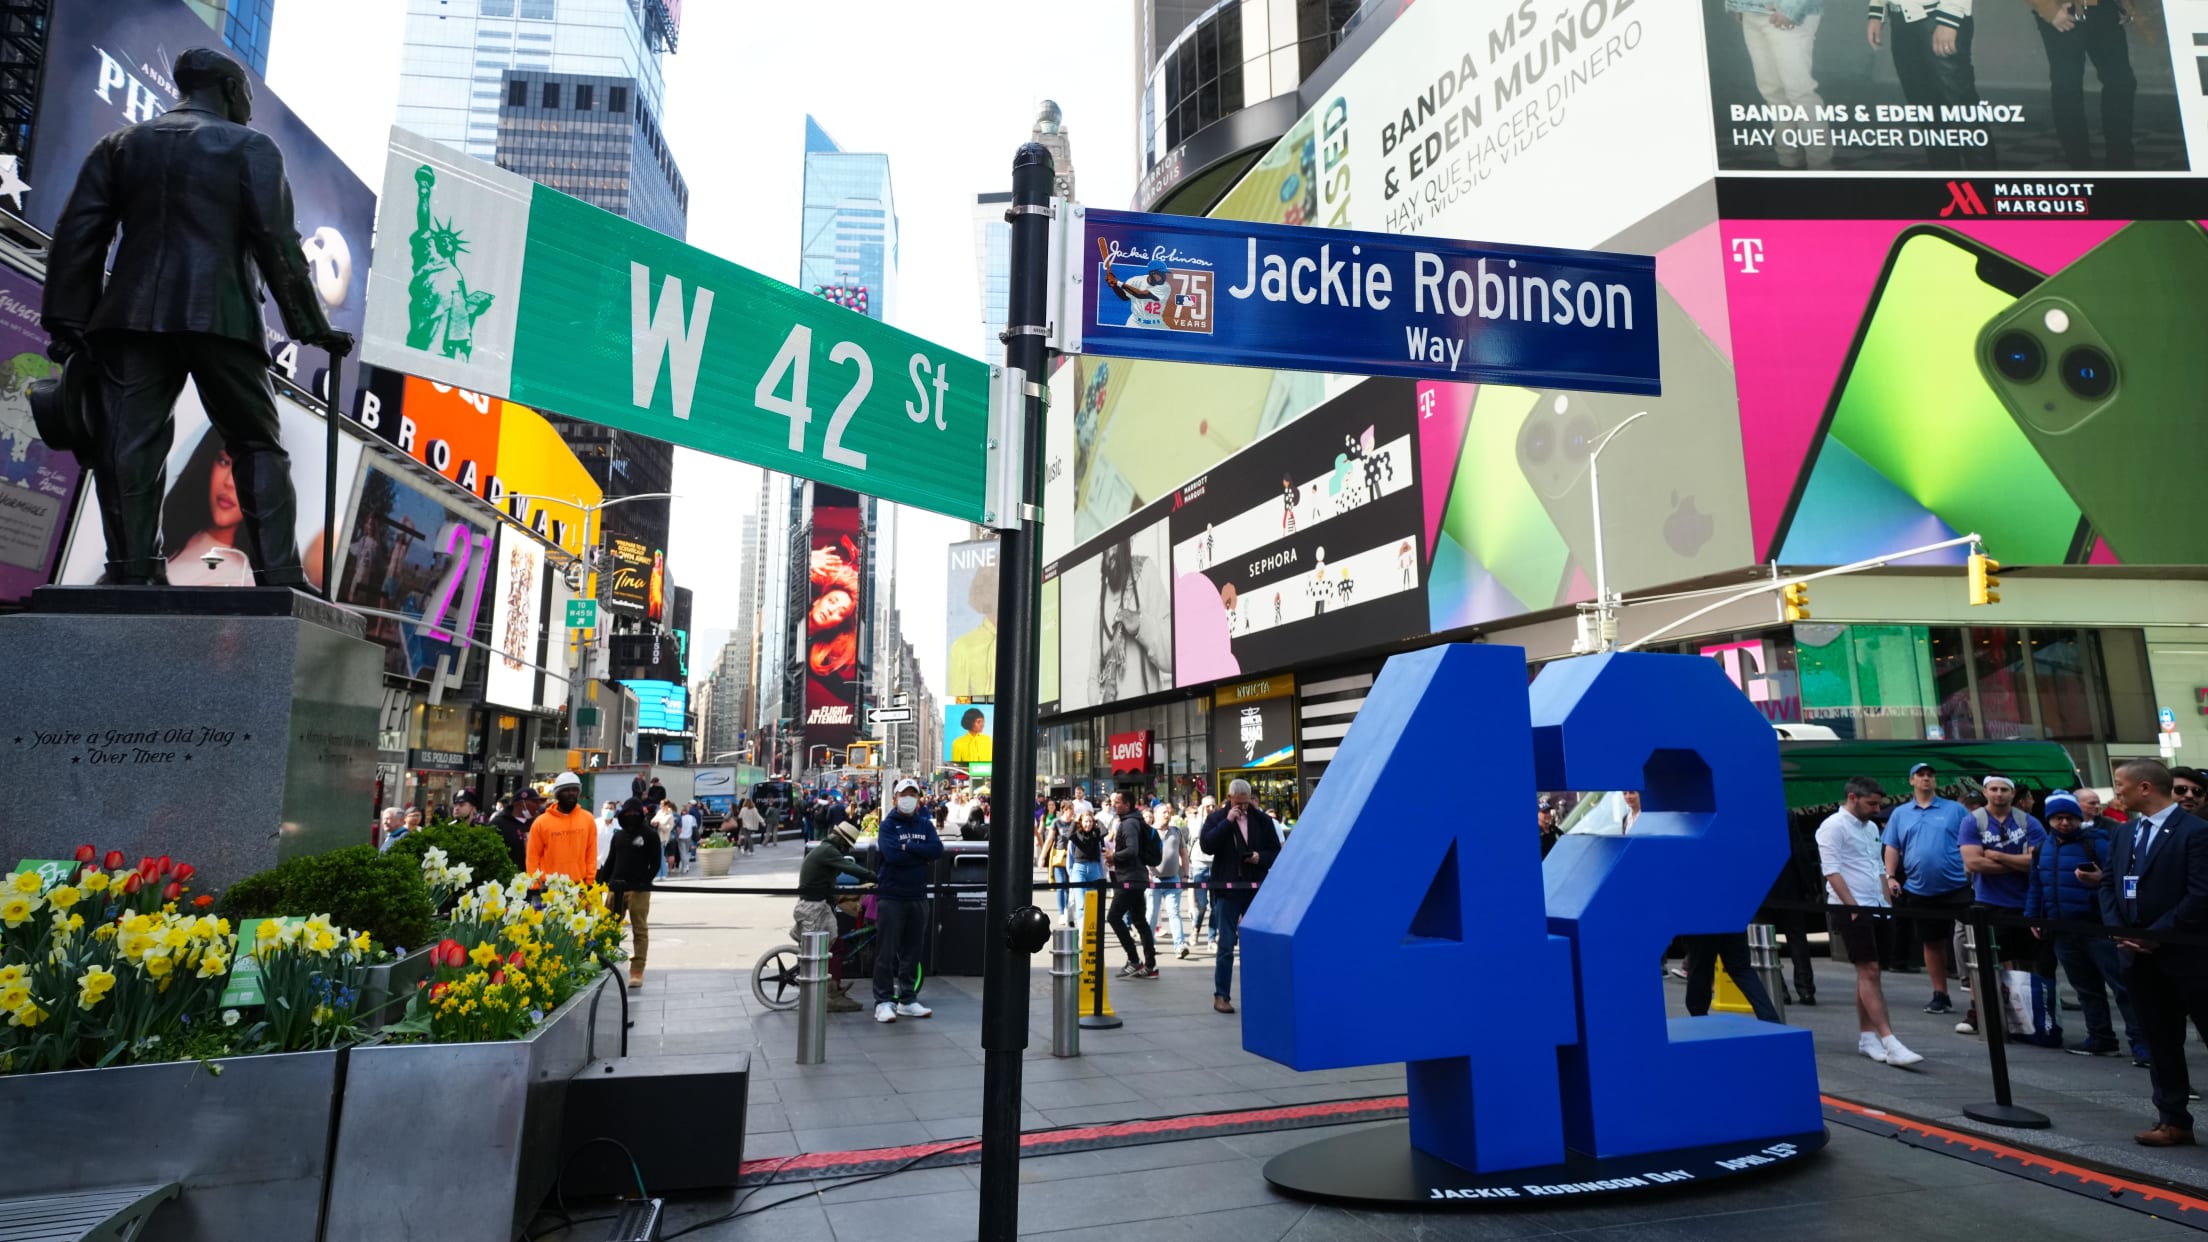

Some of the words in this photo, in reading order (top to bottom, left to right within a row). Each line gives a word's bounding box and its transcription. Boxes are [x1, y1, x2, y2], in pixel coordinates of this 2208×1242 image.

[141, 62, 181, 100] ANDRE
[1381, 52, 1478, 159] BANDA
[1487, 0, 1537, 65] MS
[1384, 166, 1400, 201] &
[1409, 94, 1482, 182] EDEN
[1493, 0, 1636, 113] MUÑO
[1730, 104, 1809, 122] BANDA
[1814, 105, 1848, 123] MS
[1854, 104, 1870, 123] &
[1876, 105, 1935, 123] EDEN
[1940, 100, 2025, 123] MUÑOZ
[1386, 191, 1419, 233] HAY
[1424, 158, 1462, 203] QUE
[1466, 100, 1540, 173] HACER
[1546, 20, 1642, 112] DINERO
[1732, 128, 1776, 147] HAY
[1781, 129, 1826, 149] QUE
[1831, 129, 1904, 147] HACER
[1909, 129, 1989, 147] DINERO
[1994, 183, 2095, 197] MARRIOTT
[1996, 199, 2087, 214] MARQUIS
[1103, 240, 1150, 270] Jackie
[1151, 245, 1214, 267] Robinson
[1173, 273, 1207, 321] 75
[1228, 237, 1393, 311] Jackie
[1414, 251, 1633, 330] Robinson
[1144, 301, 1162, 315] 42
[1173, 319, 1208, 328] YEARS
[1405, 326, 1465, 372] Way
[630, 260, 716, 421] W
[754, 322, 874, 470] 42
[905, 352, 950, 431] St
[951, 547, 996, 571] NINE
[1248, 547, 1298, 578] SEPHORA
[612, 567, 647, 591] Tina
[31, 730, 81, 749] You're
[86, 734, 98, 745] a
[104, 729, 157, 748] Grand
[163, 728, 194, 743] Old
[198, 727, 235, 746] Flag
[88, 748, 127, 764] Over
[132, 748, 175, 763] There
[1240, 643, 1824, 1174] 42
[1715, 1149, 1777, 1171] APRIL
[1430, 1187, 1521, 1199] JACKIE
[1527, 1172, 1649, 1196] ROBINSON
[1643, 1168, 1697, 1184] DAY
